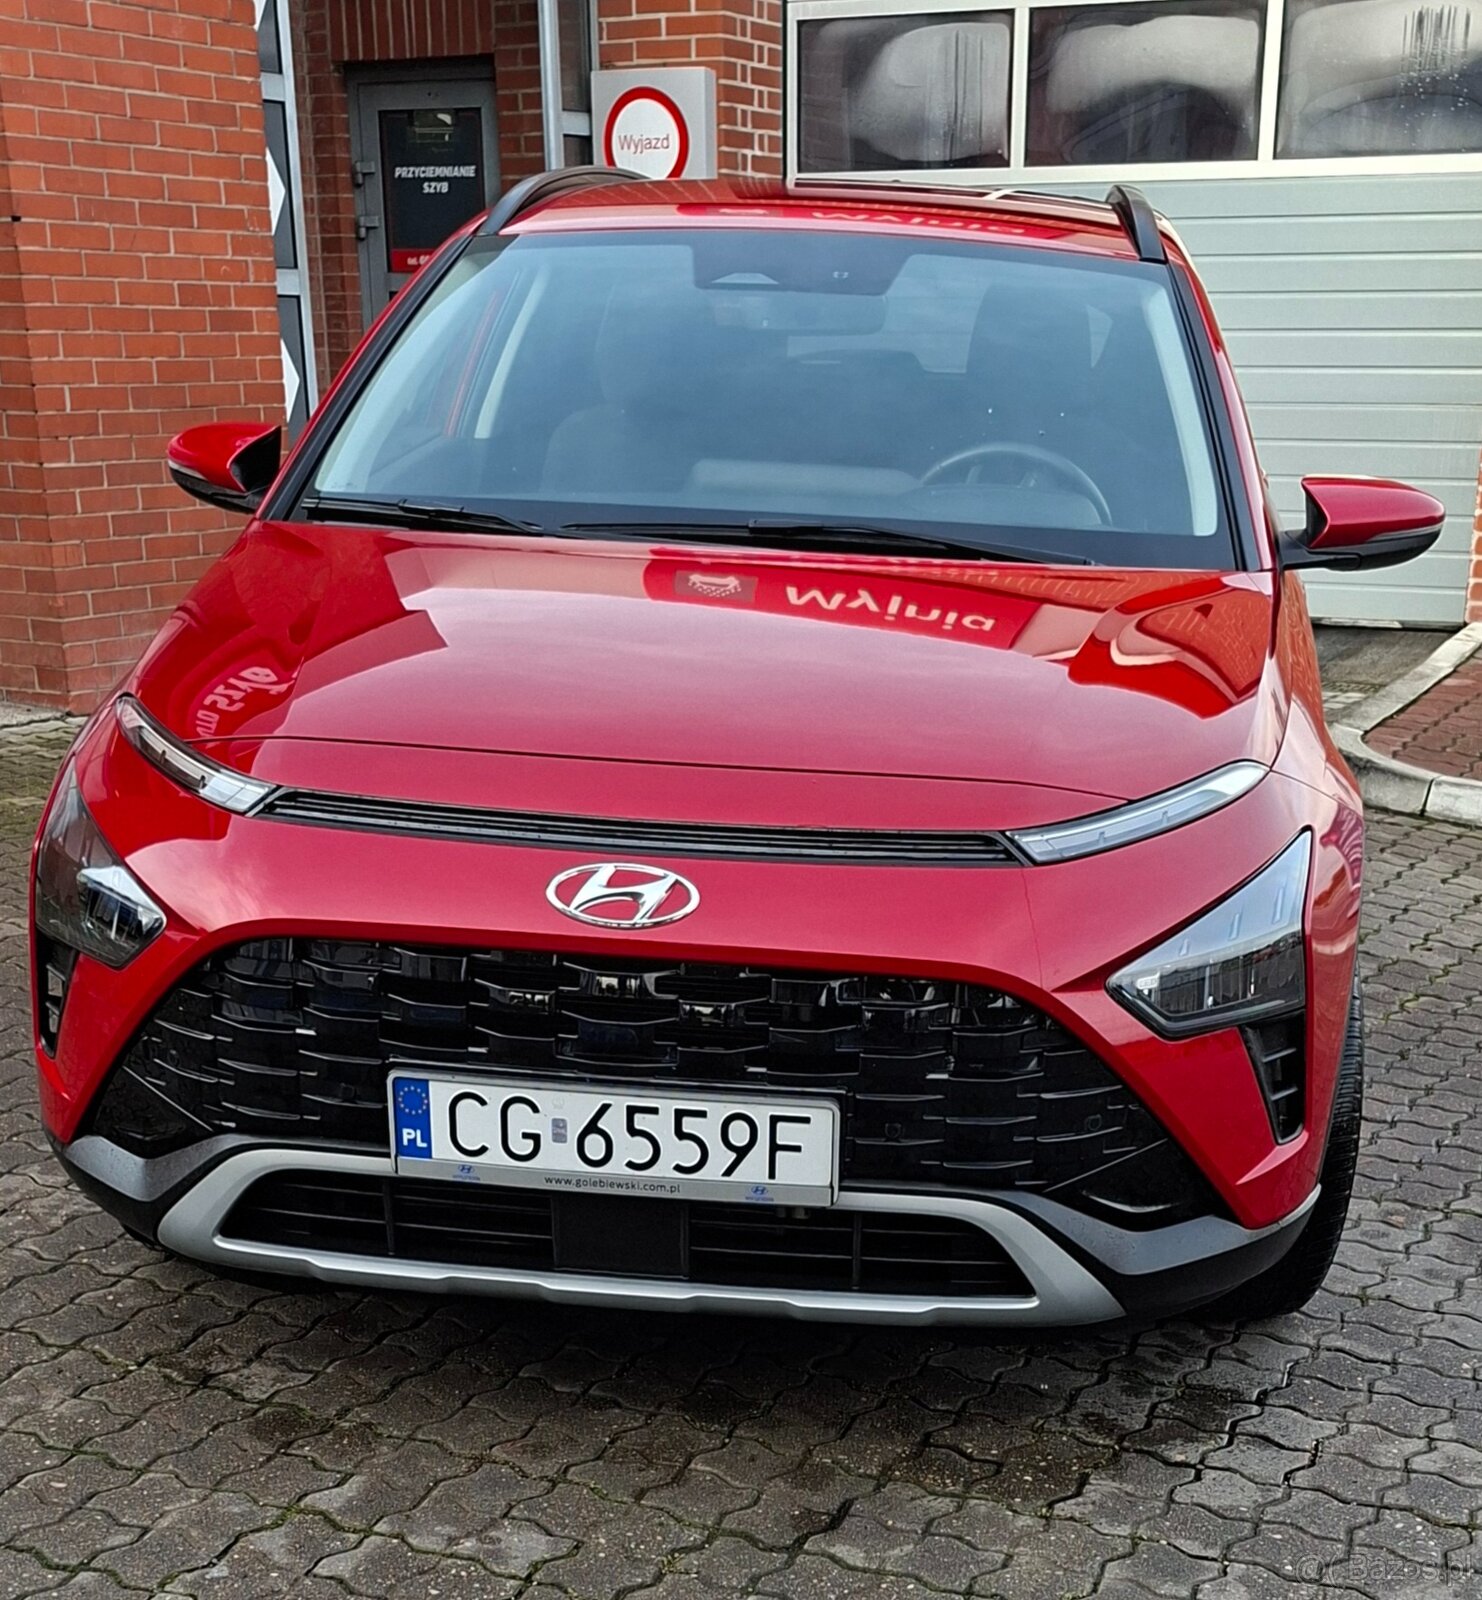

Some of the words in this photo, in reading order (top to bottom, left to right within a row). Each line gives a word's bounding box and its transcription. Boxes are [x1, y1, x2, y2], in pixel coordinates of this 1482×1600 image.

[618, 134, 670, 154] Wyjazd
[394, 165, 476, 178] PRZYCIEMNIANIE
[422, 181, 449, 193] SZYB
[402, 1128, 428, 1147] PL
[449, 1091, 541, 1162] CG
[576, 1102, 811, 1180] 6559F
[544, 1175, 681, 1194] www.golebiewski.com.pl
